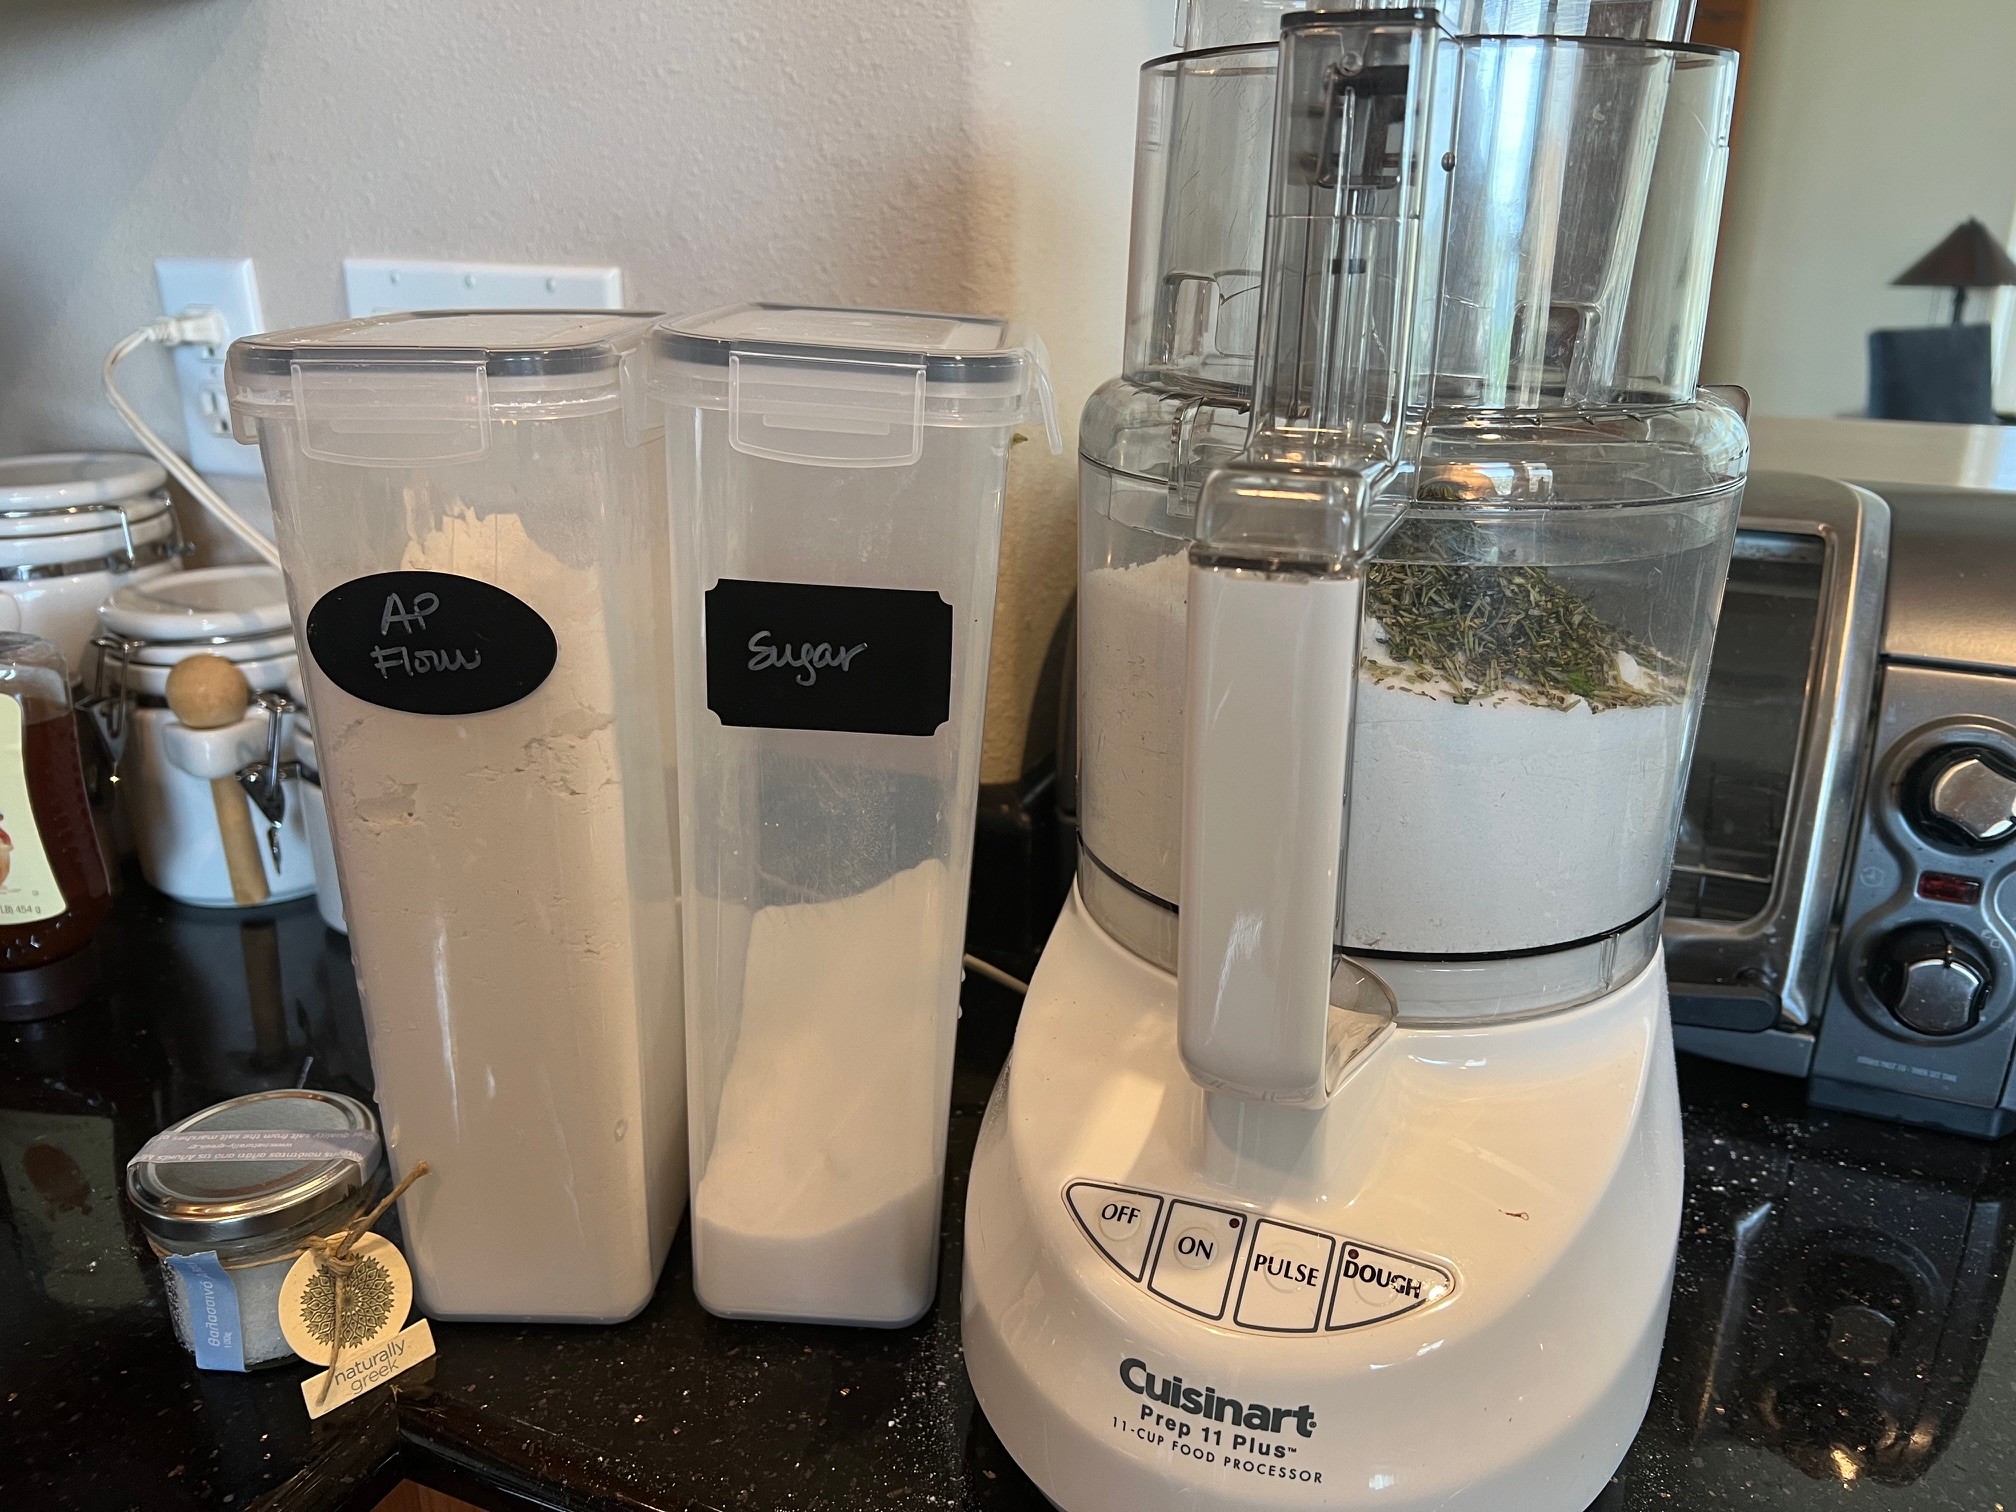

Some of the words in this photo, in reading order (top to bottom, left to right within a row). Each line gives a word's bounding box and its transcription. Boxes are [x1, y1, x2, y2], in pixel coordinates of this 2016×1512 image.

[380, 592, 440, 636] AP
[747, 630, 868, 687] Sugar
[220, 1133, 241, 1141] salt
[243, 1133, 261, 1141] the
[1101, 1203, 1141, 1225] OFF
[1177, 1235, 1214, 1261] ON
[1253, 1253, 1320, 1288] PULSE
[1342, 1259, 1422, 1299] DOUGH
[334, 1339, 405, 1386] naturally
[350, 1359, 399, 1395] greek
[1140, 1403, 1191, 1439] Prep
[1201, 1426, 1222, 1446] 11
[1112, 1416, 1165, 1446] 11-CUP
[1172, 1440, 1215, 1463] FOOD
[1223, 1455, 1323, 1484] PROCESSOR
